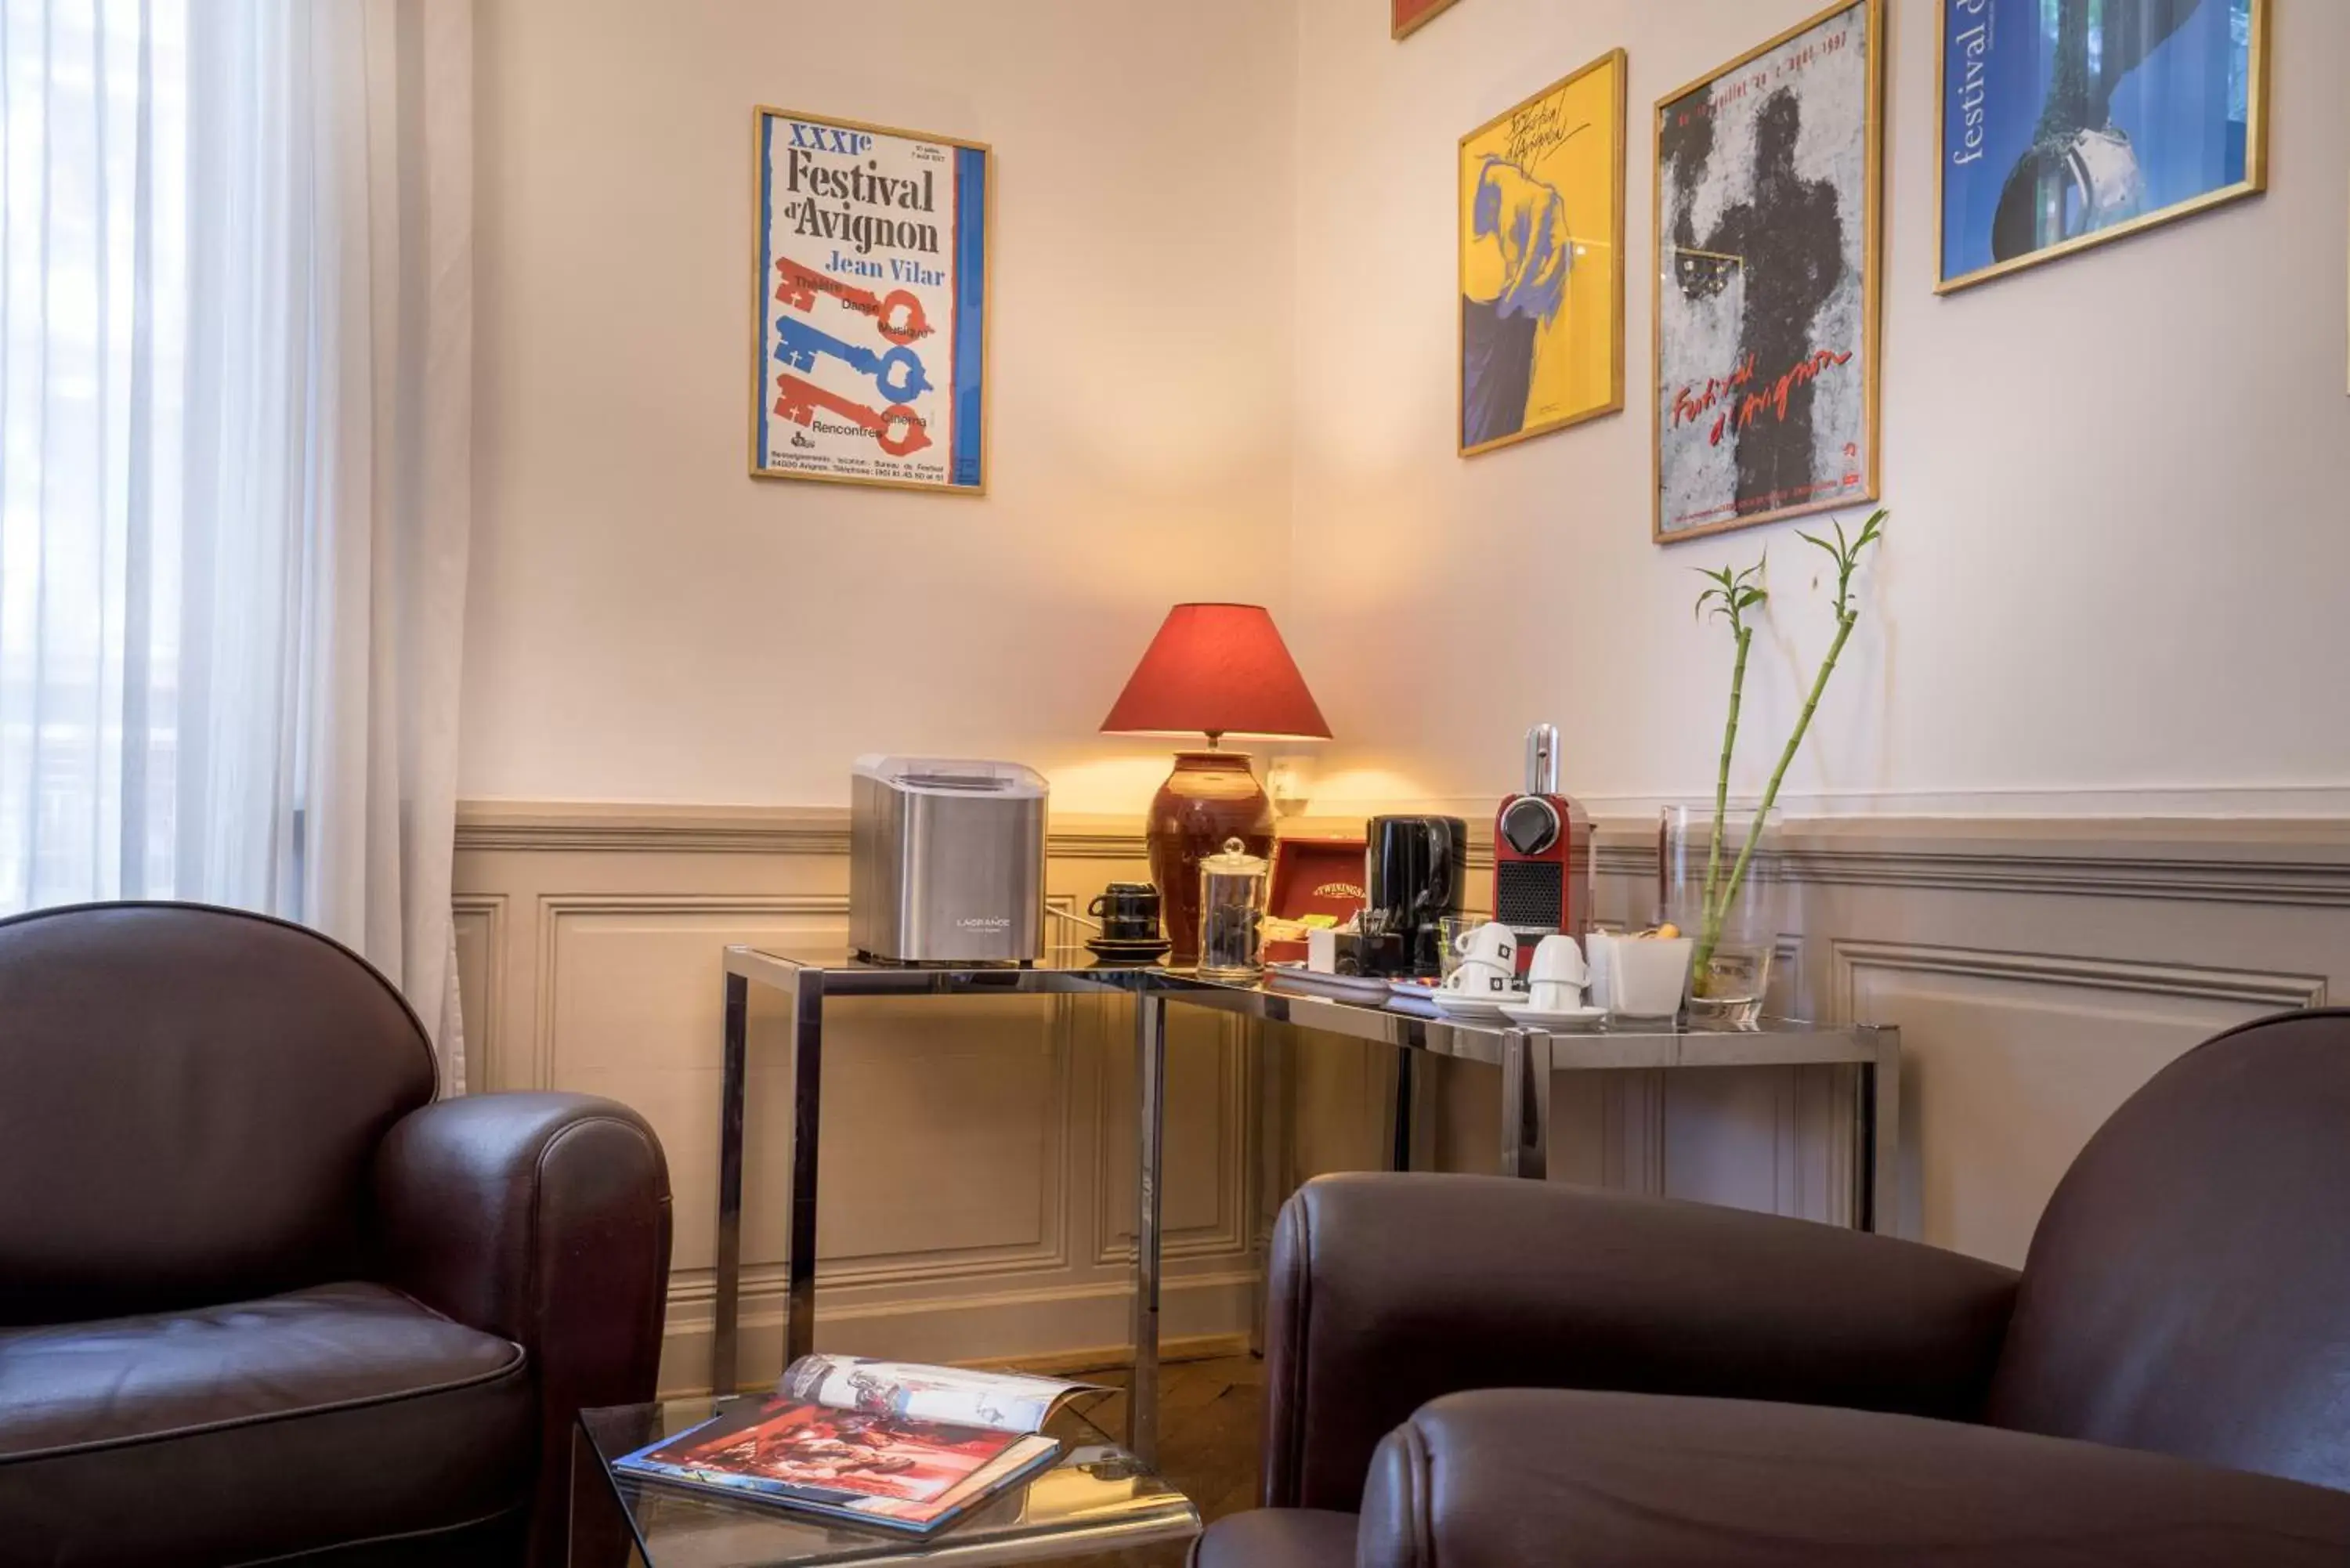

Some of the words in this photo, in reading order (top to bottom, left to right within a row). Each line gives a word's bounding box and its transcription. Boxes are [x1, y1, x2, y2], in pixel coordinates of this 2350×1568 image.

[1953, 22, 1985, 165] festival
[786, 147, 936, 213] Festival
[783, 196, 940, 255] d'Avignon
[825, 249, 884, 279] Jean
[890, 257, 946, 287] Vilar
[841, 297, 880, 315] Danse
[880, 410, 927, 428] Cinéma
[812, 420, 884, 439] Rencontres
[1317, 883, 1364, 898] TWININGS
[956, 918, 1010, 927] LAGRANGE
